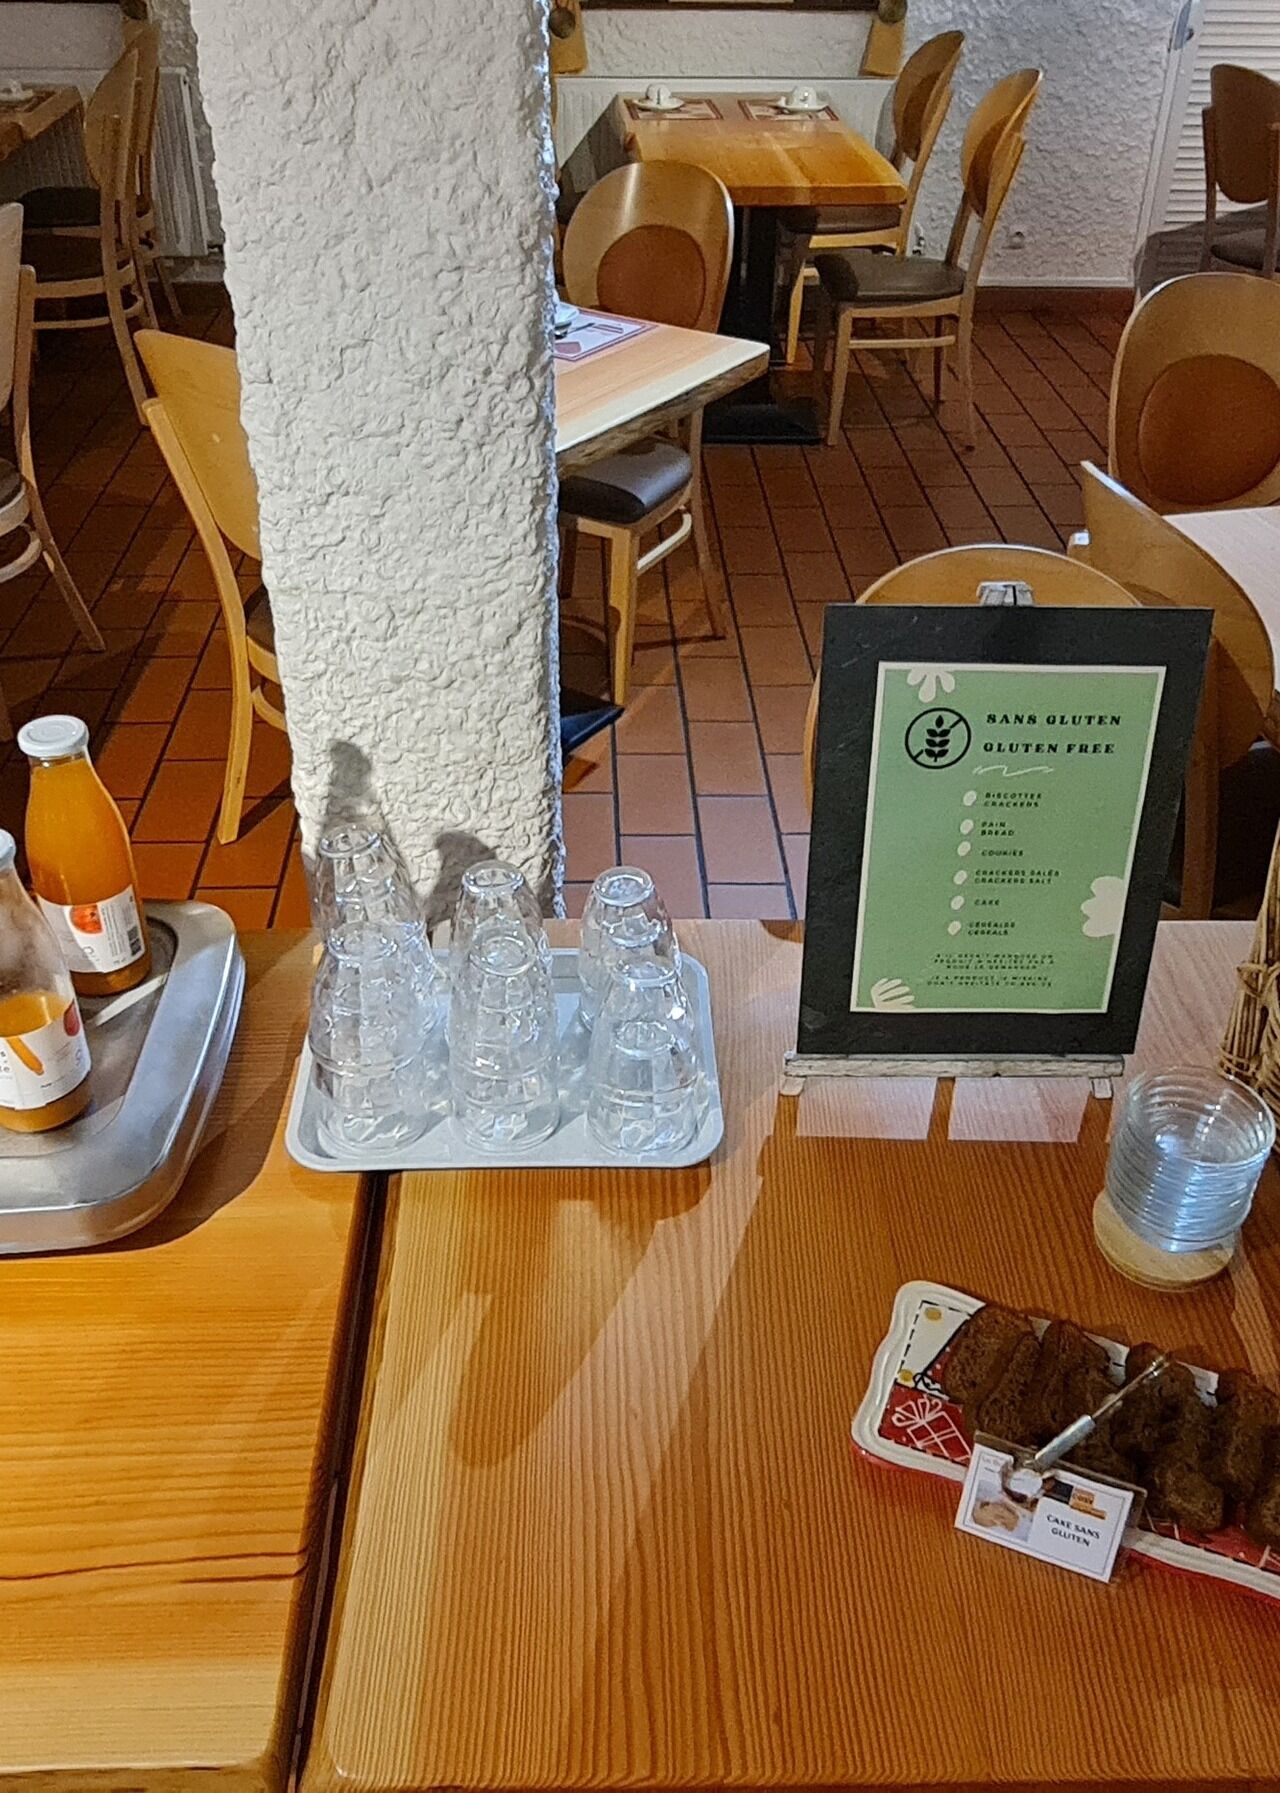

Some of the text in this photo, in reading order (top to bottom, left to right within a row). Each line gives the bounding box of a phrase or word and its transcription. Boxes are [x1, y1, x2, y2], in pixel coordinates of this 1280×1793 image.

[986, 713, 1121, 726] SANS GLUTEN
[983, 742, 1115, 754] GLUTEN FREE
[1046, 1514, 1101, 1540] CAKE SANS
[1051, 1527, 1090, 1547] GLUTEN
